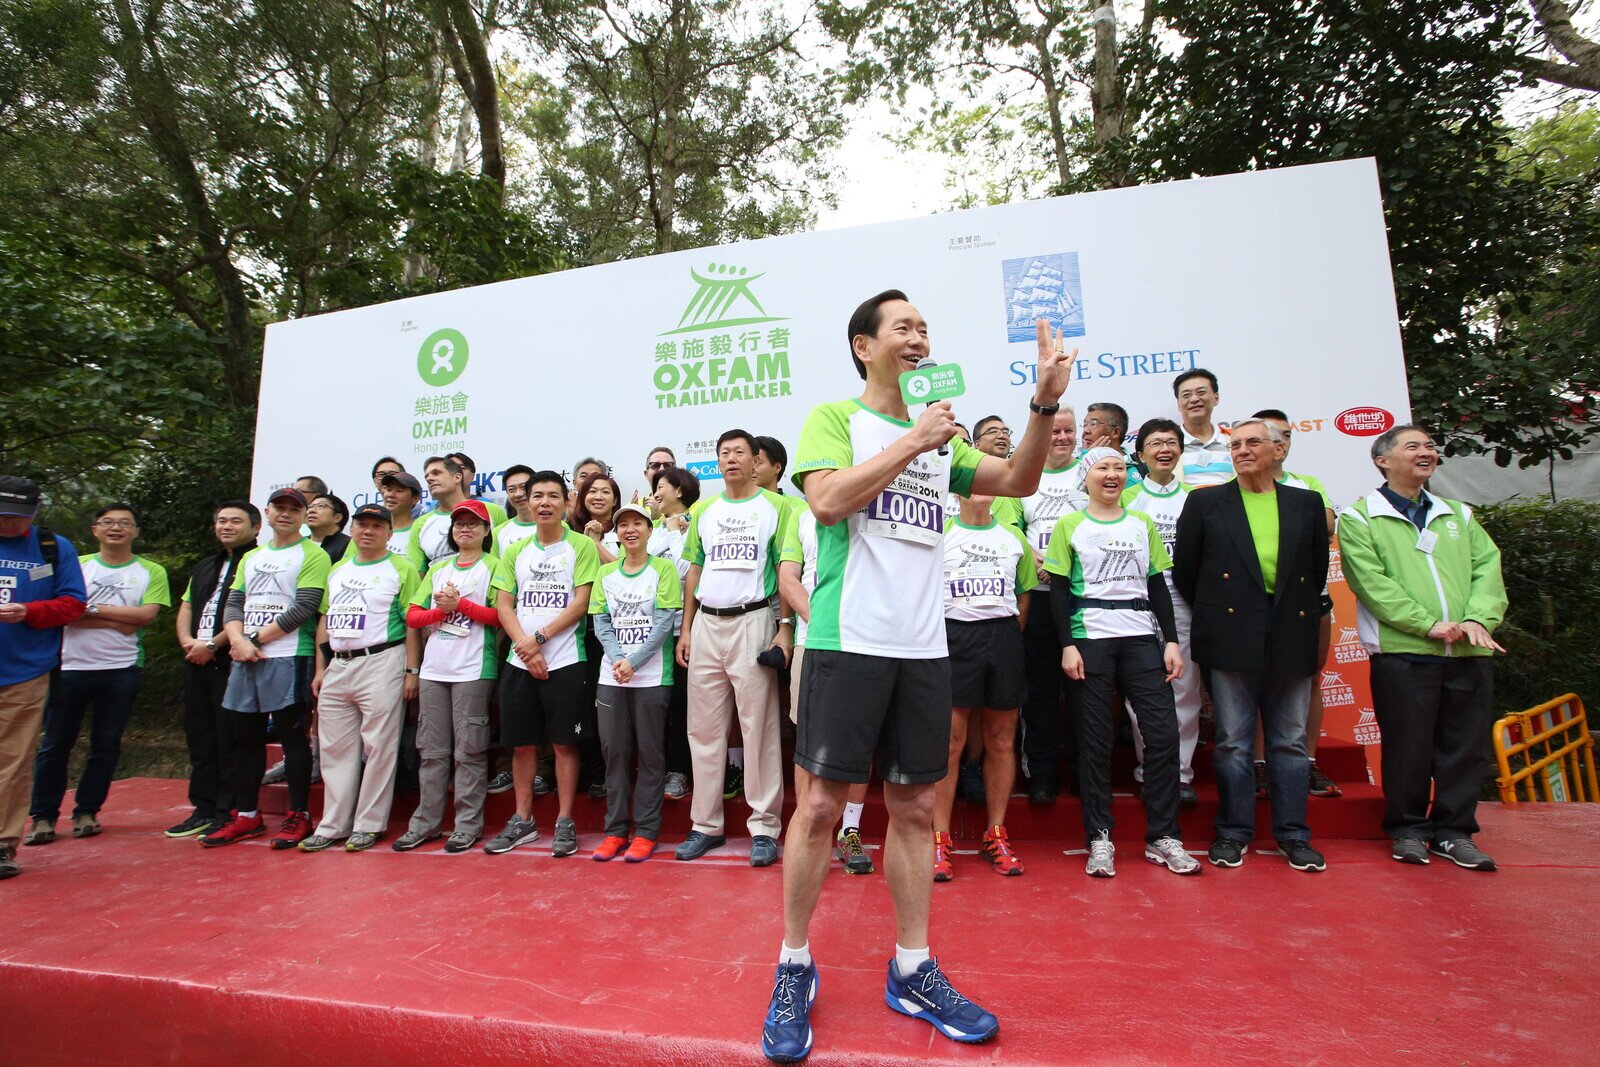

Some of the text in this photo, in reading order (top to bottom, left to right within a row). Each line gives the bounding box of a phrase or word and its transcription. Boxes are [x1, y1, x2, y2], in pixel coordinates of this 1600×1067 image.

[654, 327, 792, 363] 樂施毅行者
[653, 350, 792, 392] OXFAM
[1009, 349, 1201, 386] STE STREET
[932, 377, 958, 389] OXFAM
[414, 391, 469, 416] 樂施會
[654, 380, 793, 410] TRAILWALKER
[1343, 412, 1385, 424] 維他奶
[1343, 422, 1386, 431] vitasoy
[412, 416, 468, 439] OXFAM
[413, 440, 465, 454] Hong Kong
[686, 439, 719, 449] 大會指定
[686, 446, 704, 455] Official
[919, 485, 940, 500] 2014
[876, 491, 938, 531] L0001
[714, 544, 756, 561] L0026
[954, 578, 1002, 597] L0029
[525, 591, 566, 608] L0023
[244, 611, 281, 627] 002
[327, 614, 361, 631] L0021
[1322, 692, 1354, 703] XFAM
[1355, 731, 1381, 742] OXFA
[911, 989, 937, 1008] BROOKS
